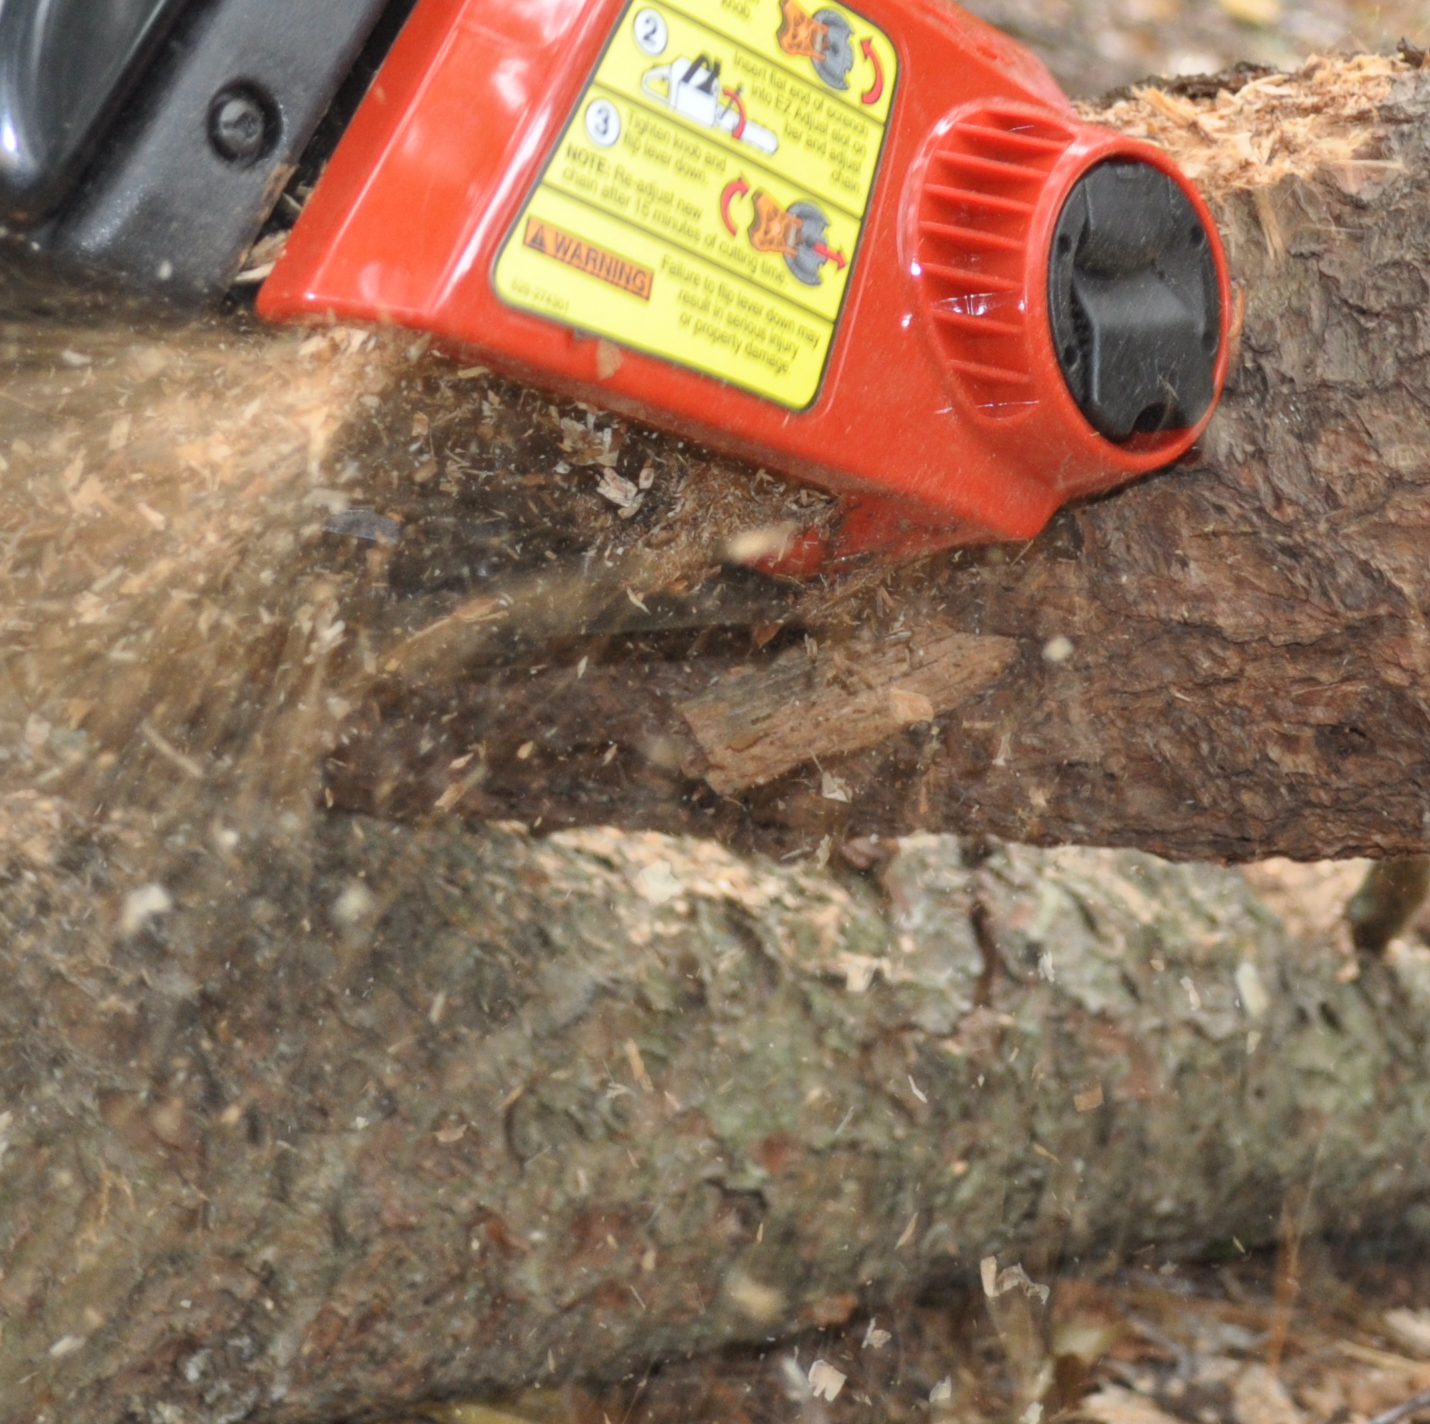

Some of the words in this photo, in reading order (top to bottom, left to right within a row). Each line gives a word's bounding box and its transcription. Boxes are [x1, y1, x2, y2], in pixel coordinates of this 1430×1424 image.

[643, 15, 658, 44] 2
[594, 106, 610, 135] 3
[734, 50, 767, 80] Insert
[770, 70, 787, 92] flat
[790, 85, 810, 105] end
[813, 97, 825, 112] of
[827, 107, 869, 136] scrench
[751, 83, 772, 105] into
[775, 95, 792, 115] EZ
[794, 106, 828, 134] Adjust
[831, 125, 851, 145] slot
[853, 140, 866, 155] on
[624, 130, 642, 154] flip
[645, 141, 672, 166] lever
[675, 157, 708, 185] down.
[629, 109, 671, 141] Tighten
[673, 131, 702, 159] knob
[705, 151, 727, 171] and
[784, 120, 802, 140] bar
[806, 136, 827, 155] and
[829, 147, 862, 173] adjust
[566, 144, 611, 173] NOTE:
[614, 164, 674, 204] Re-adjust
[676, 198, 704, 220] new
[563, 167, 598, 193] chain
[602, 184, 631, 207] after
[635, 198, 650, 217] 15
[652, 209, 702, 242] minutes
[704, 232, 718, 248] of
[719, 241, 759, 274] cutting
[554, 231, 649, 293] WARNING
[660, 254, 701, 286] Failure
[704, 274, 716, 293] to
[717, 282, 735, 306] flip
[737, 290, 765, 316] lever
[766, 307, 796, 332] down
[797, 324, 821, 349] may
[679, 288, 711, 312] result
[713, 304, 724, 319] in
[726, 311, 768, 339] serious
[769, 328, 799, 360] injury
[679, 311, 693, 326] or
[693, 319, 743, 355] property
